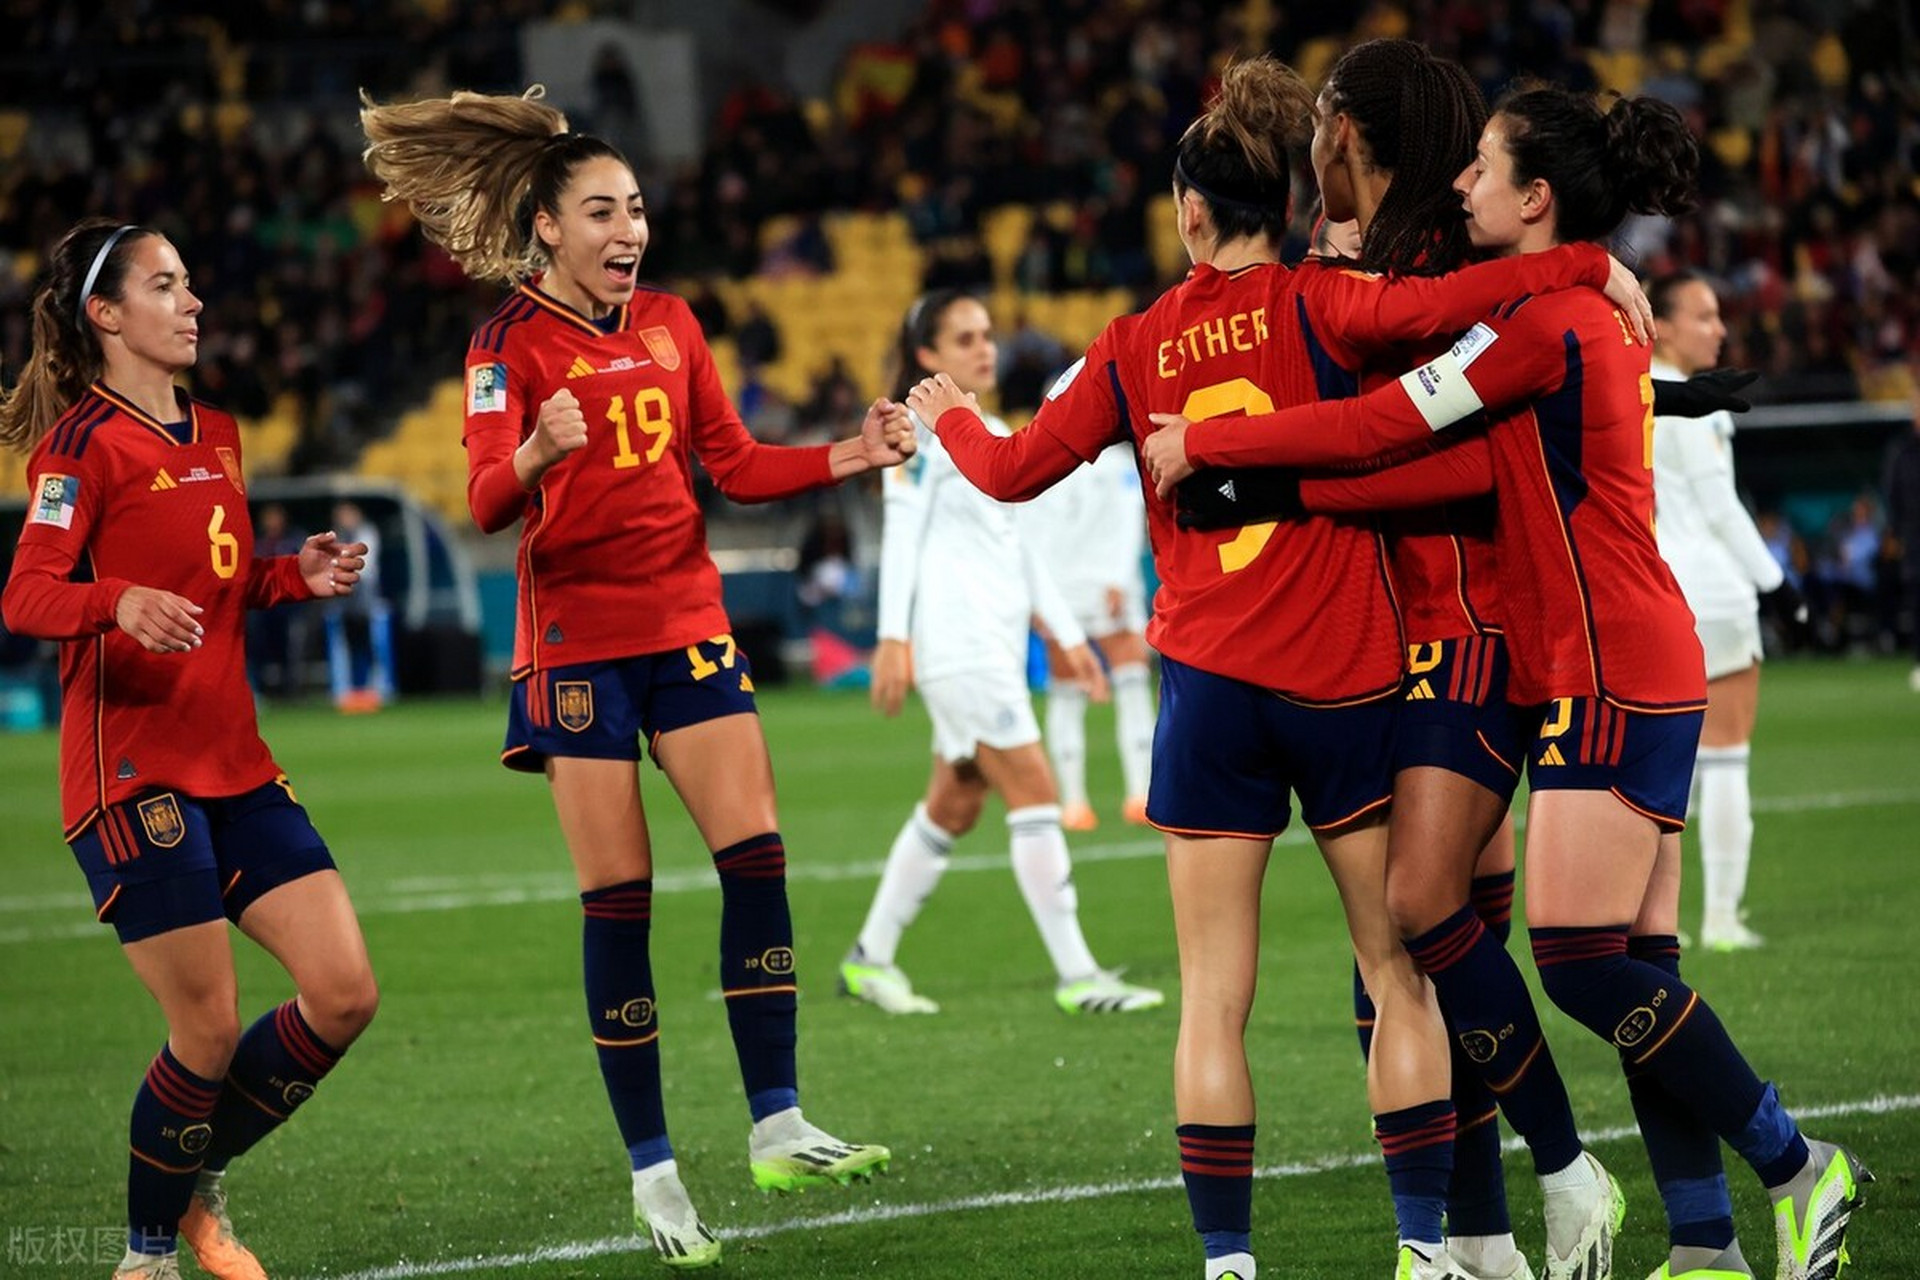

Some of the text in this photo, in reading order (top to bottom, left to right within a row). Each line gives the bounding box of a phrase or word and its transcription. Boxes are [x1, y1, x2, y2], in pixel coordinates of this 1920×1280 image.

[1158, 307, 1269, 379] ESTHER
[606, 387, 672, 469] 19
[208, 505, 238, 579] 6
